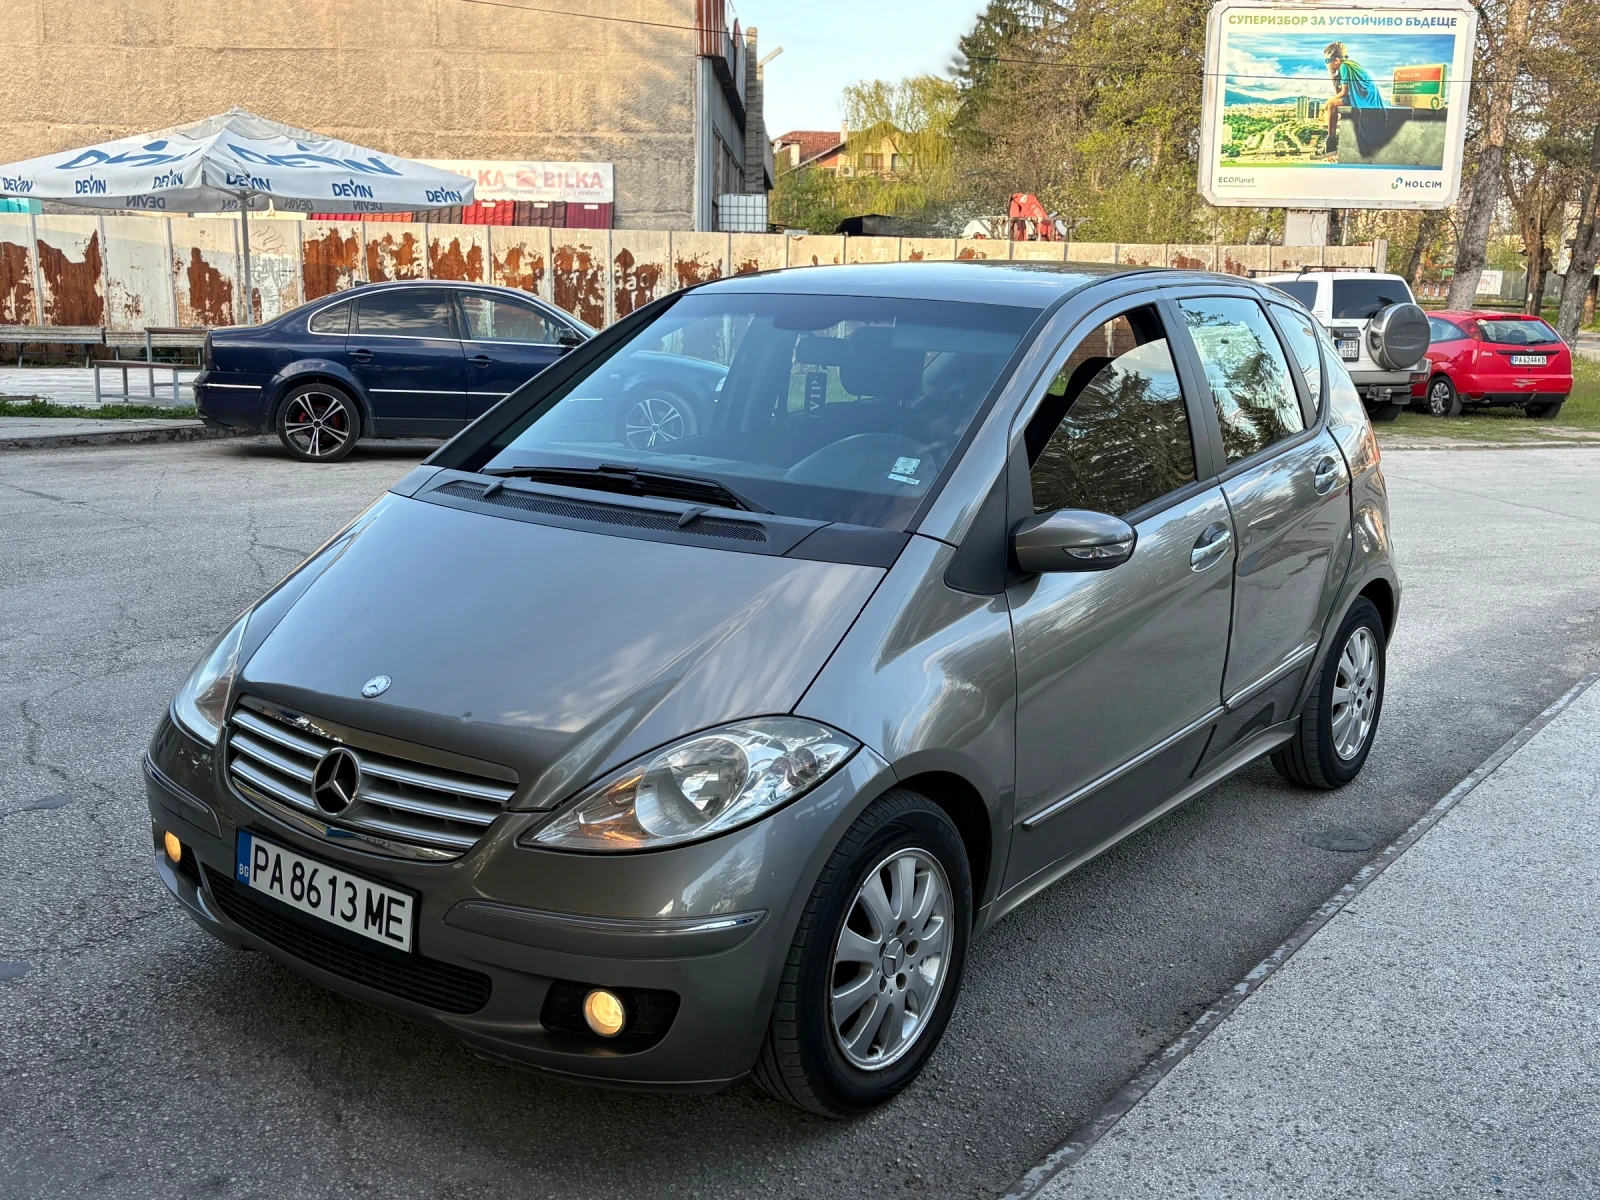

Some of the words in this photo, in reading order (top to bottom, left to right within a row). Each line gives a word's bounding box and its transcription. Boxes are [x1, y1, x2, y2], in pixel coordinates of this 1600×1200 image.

[1228, 15, 1308, 25] СУПЕРИЗБОР
[1310, 16, 1326, 26] ЗА
[1328, 15, 1403, 26] УСТОЙЧИВО
[1405, 17, 1458, 28] БЪДЕЩЕ
[2, 175, 34, 193] DEVIN
[75, 175, 107, 194] DEVIN
[152, 169, 185, 190] DEVIN
[543, 171, 604, 188] BILKA
[1405, 180, 1442, 188] HOLCIM
[332, 180, 374, 198] DEVIN
[425, 187, 462, 203] DEVIN
[810, 380, 820, 411] VIP
[238, 863, 249, 877] BG
